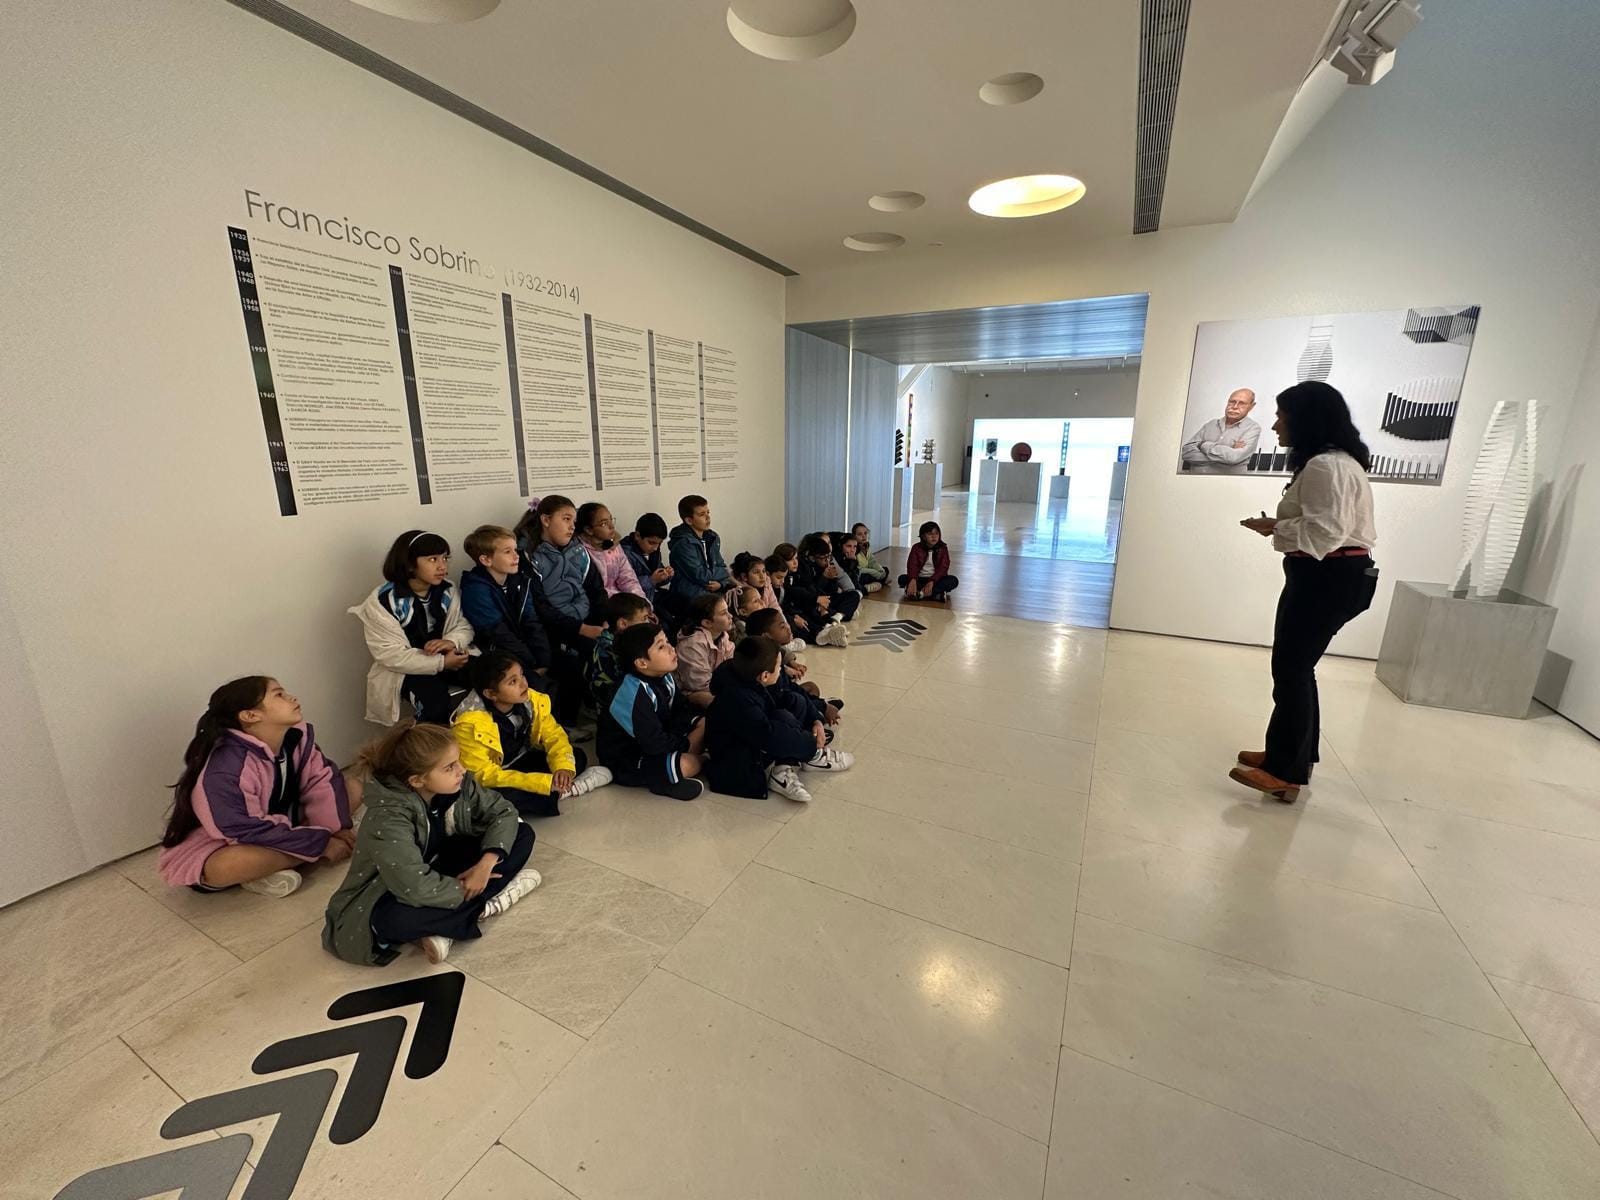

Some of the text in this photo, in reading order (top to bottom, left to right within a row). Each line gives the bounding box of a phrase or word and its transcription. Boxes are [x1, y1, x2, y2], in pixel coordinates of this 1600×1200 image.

[230, 231, 247, 240] 1932
[245, 189, 401, 255] Francisco
[409, 236, 496, 279] Sobrino
[504, 263, 580, 304] (1932-2014)
[237, 270, 254, 278] 1940
[251, 345, 267, 353] 1959
